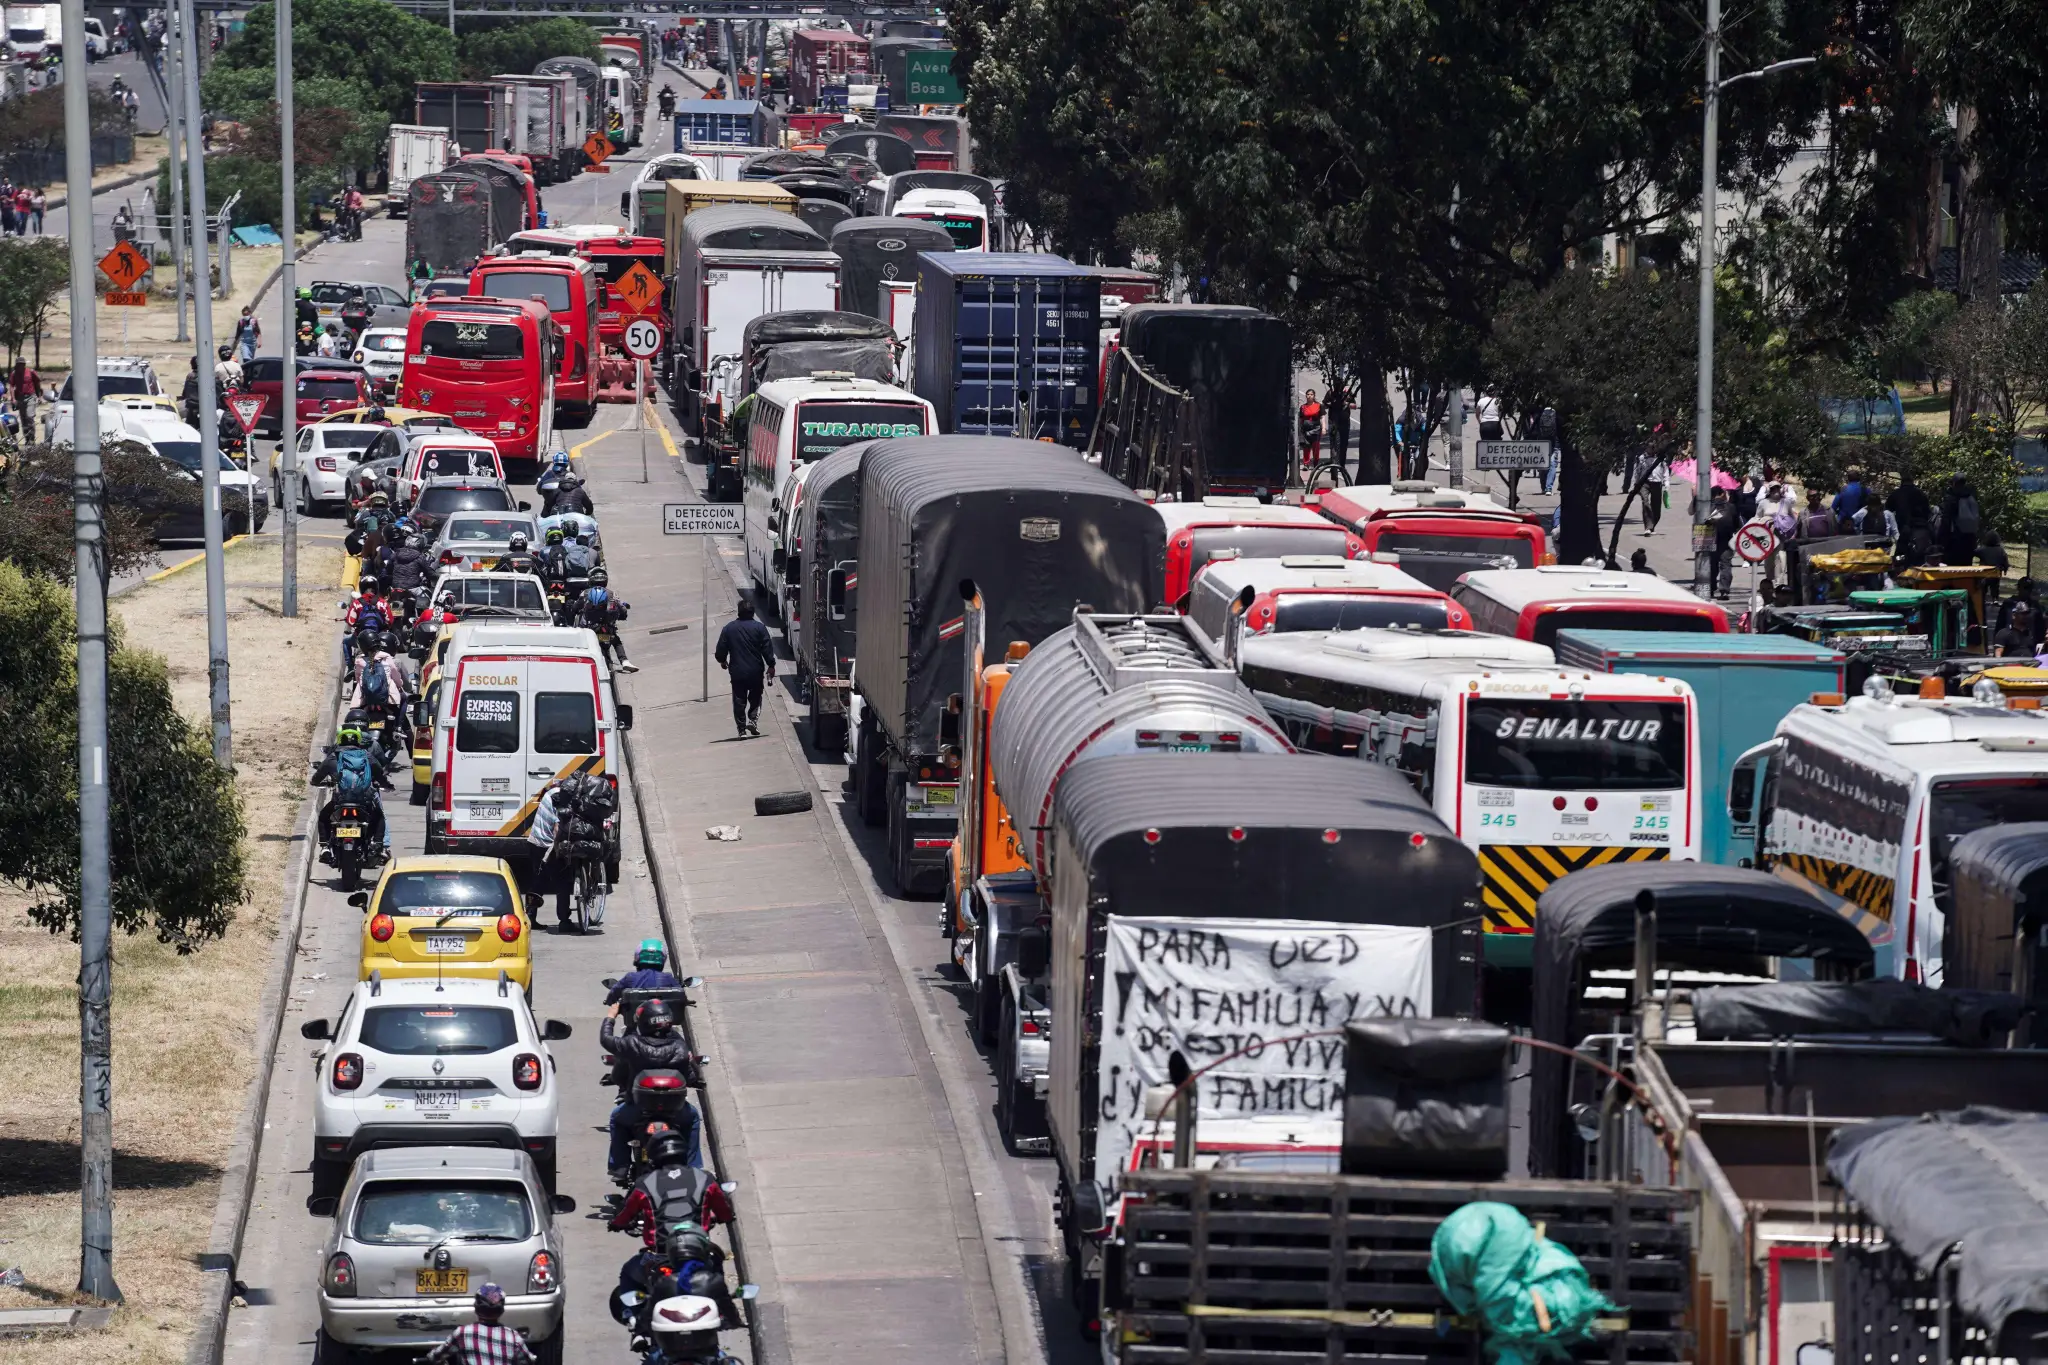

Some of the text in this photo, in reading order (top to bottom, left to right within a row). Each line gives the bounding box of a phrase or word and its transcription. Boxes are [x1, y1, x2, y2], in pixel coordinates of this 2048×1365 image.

[911, 60, 948, 73] Aven
[911, 81, 945, 94] Bosa
[631, 327, 657, 349] 50
[802, 422, 920, 438] TURANDES
[1487, 444, 1541, 454] DETECCIÓN
[675, 507, 734, 518] DETECCIÓN
[668, 519, 741, 530] ELECTRÓNICA
[469, 675, 518, 686] ESCOLAR
[466, 700, 513, 713] EXPRESOS
[466, 712, 512, 722] 3225871904
[1495, 716, 1662, 742] SENALTUR
[1480, 813, 1517, 827] 345
[1633, 815, 1669, 829] 345
[1138, 927, 1231, 971] PARA
